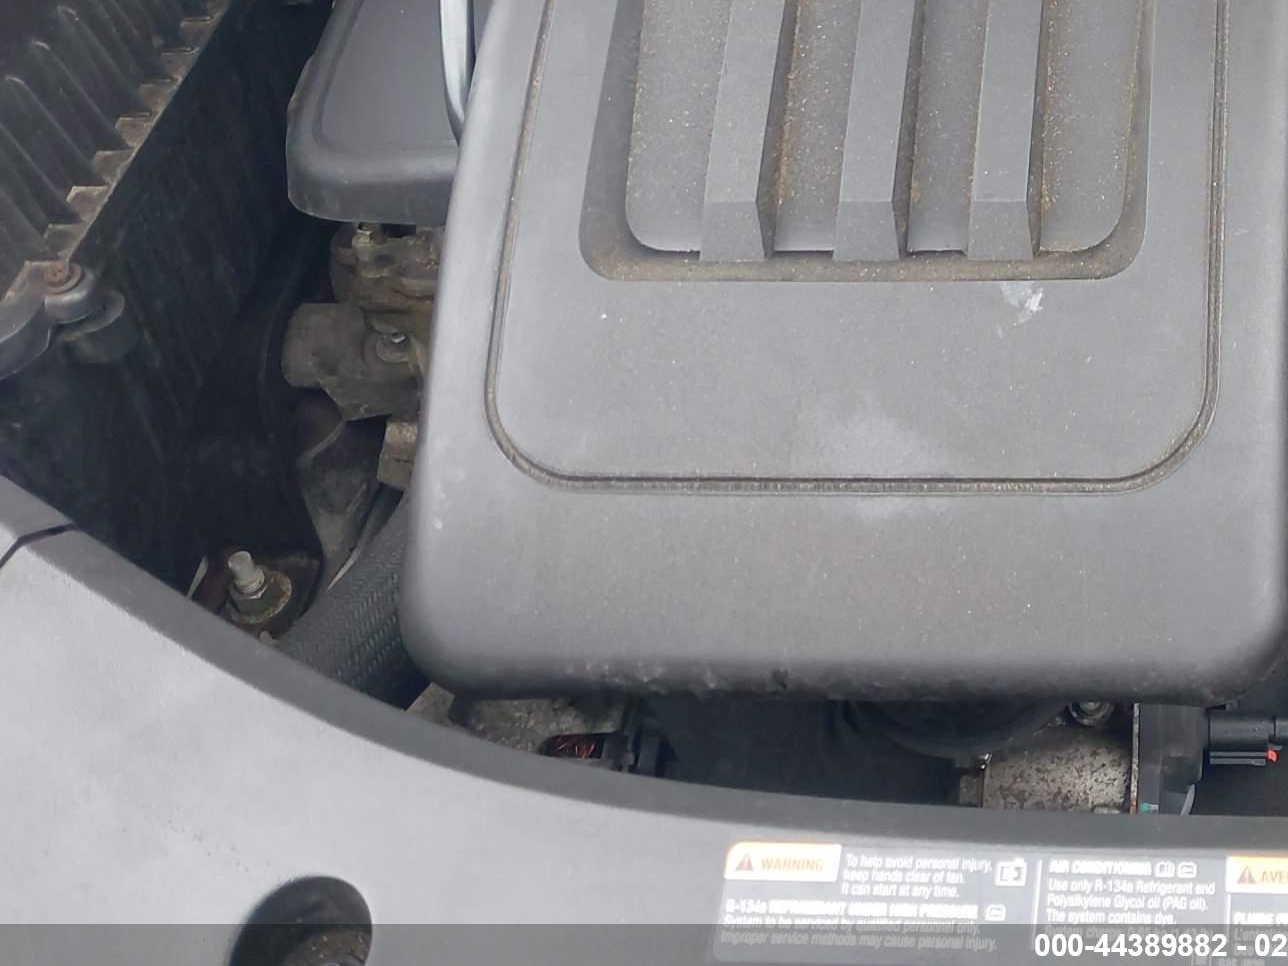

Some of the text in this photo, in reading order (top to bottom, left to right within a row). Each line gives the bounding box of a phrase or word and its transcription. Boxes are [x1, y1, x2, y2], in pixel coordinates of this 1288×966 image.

[761, 858, 823, 872] WARNING
[846, 854, 858, 867] To
[860, 854, 882, 869] help
[885, 855, 913, 868] avoid
[915, 856, 959, 872] personal
[872, 870, 903, 882] hands
[906, 870, 931, 883] clear
[933, 870, 945, 883] of
[851, 884, 870, 896] can
[872, 884, 897, 896] start
[899, 884, 910, 896] at
[912, 886, 931, 899] any
[1049, 878, 1216, 896] Use only R-134a Refrigerant and
[1048, 893, 1112, 909] Polyalkylene
[1114, 894, 1145, 910] Glycol
[1148, 895, 1160, 908] oil
[1163, 895, 1187, 911] (PAG
[1046, 908, 1066, 922] The
[1068, 910, 1106, 925] system
[1108, 910, 1152, 924] contains
[918, 936, 964, 950] personal
